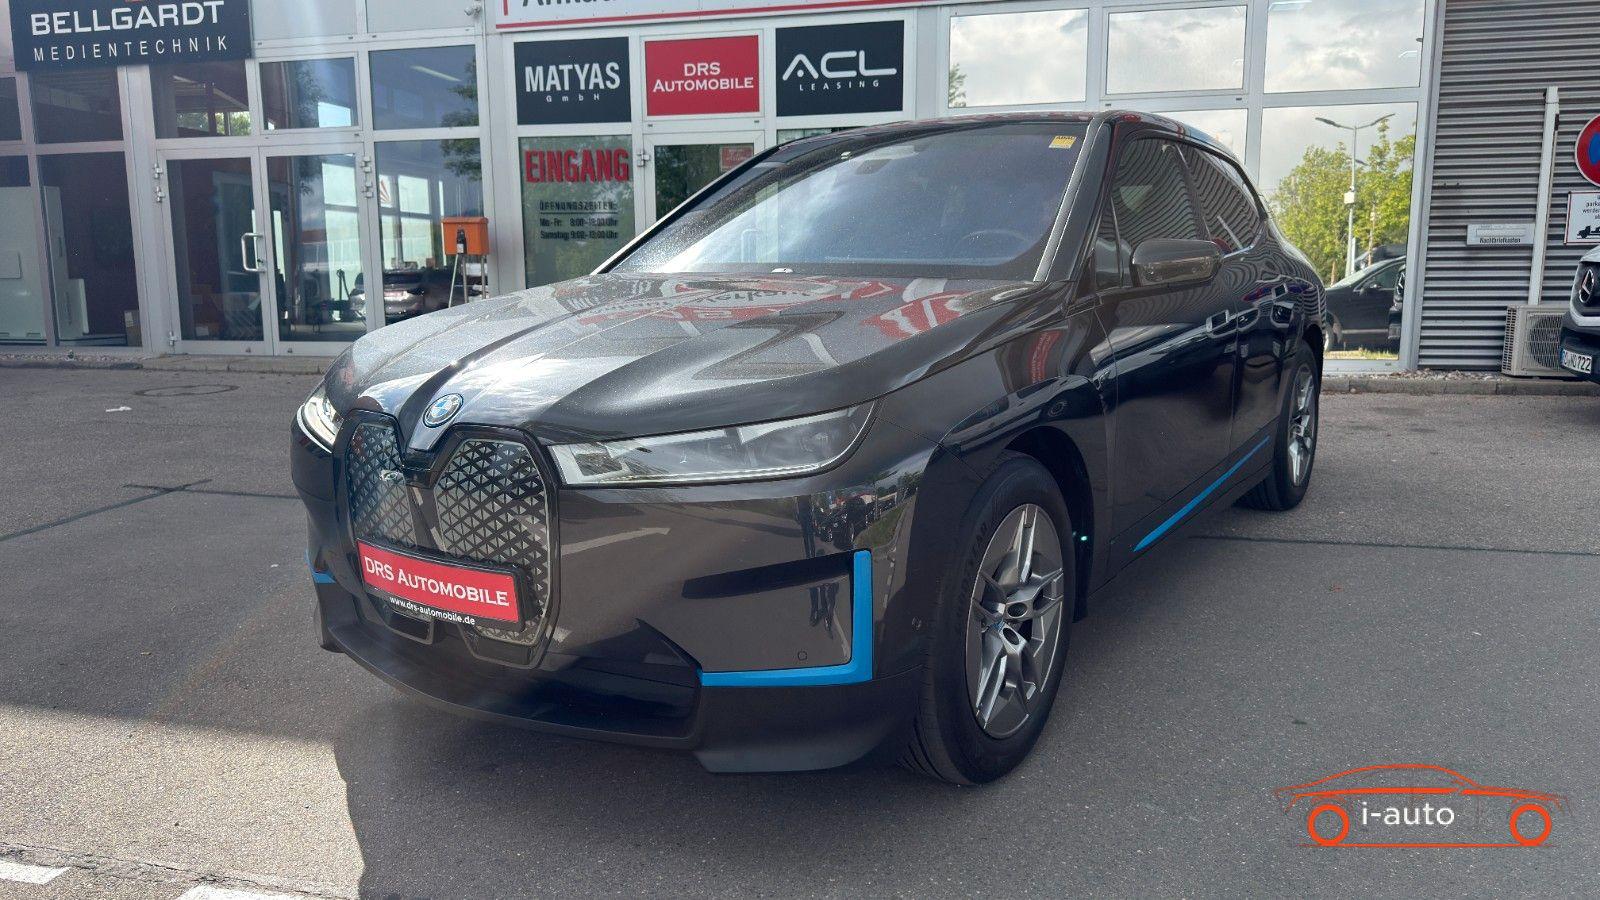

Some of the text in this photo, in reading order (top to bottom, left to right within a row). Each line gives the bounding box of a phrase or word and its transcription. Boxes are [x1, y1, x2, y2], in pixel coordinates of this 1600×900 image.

[31, 1, 224, 35] BELLGARDT
[34, 36, 227, 61] MEDIENTECHNIK
[525, 62, 620, 92] MATYAS
[684, 62, 720, 77] DRS
[782, 50, 897, 81] ACL
[653, 77, 754, 92] AUTOMOBILE
[799, 80, 879, 91] LEASING
[525, 148, 630, 183] EINGANG
[364, 556, 510, 607] DRS AUTOMOBILE
[389, 596, 476, 626] www.drs-automobile.de
